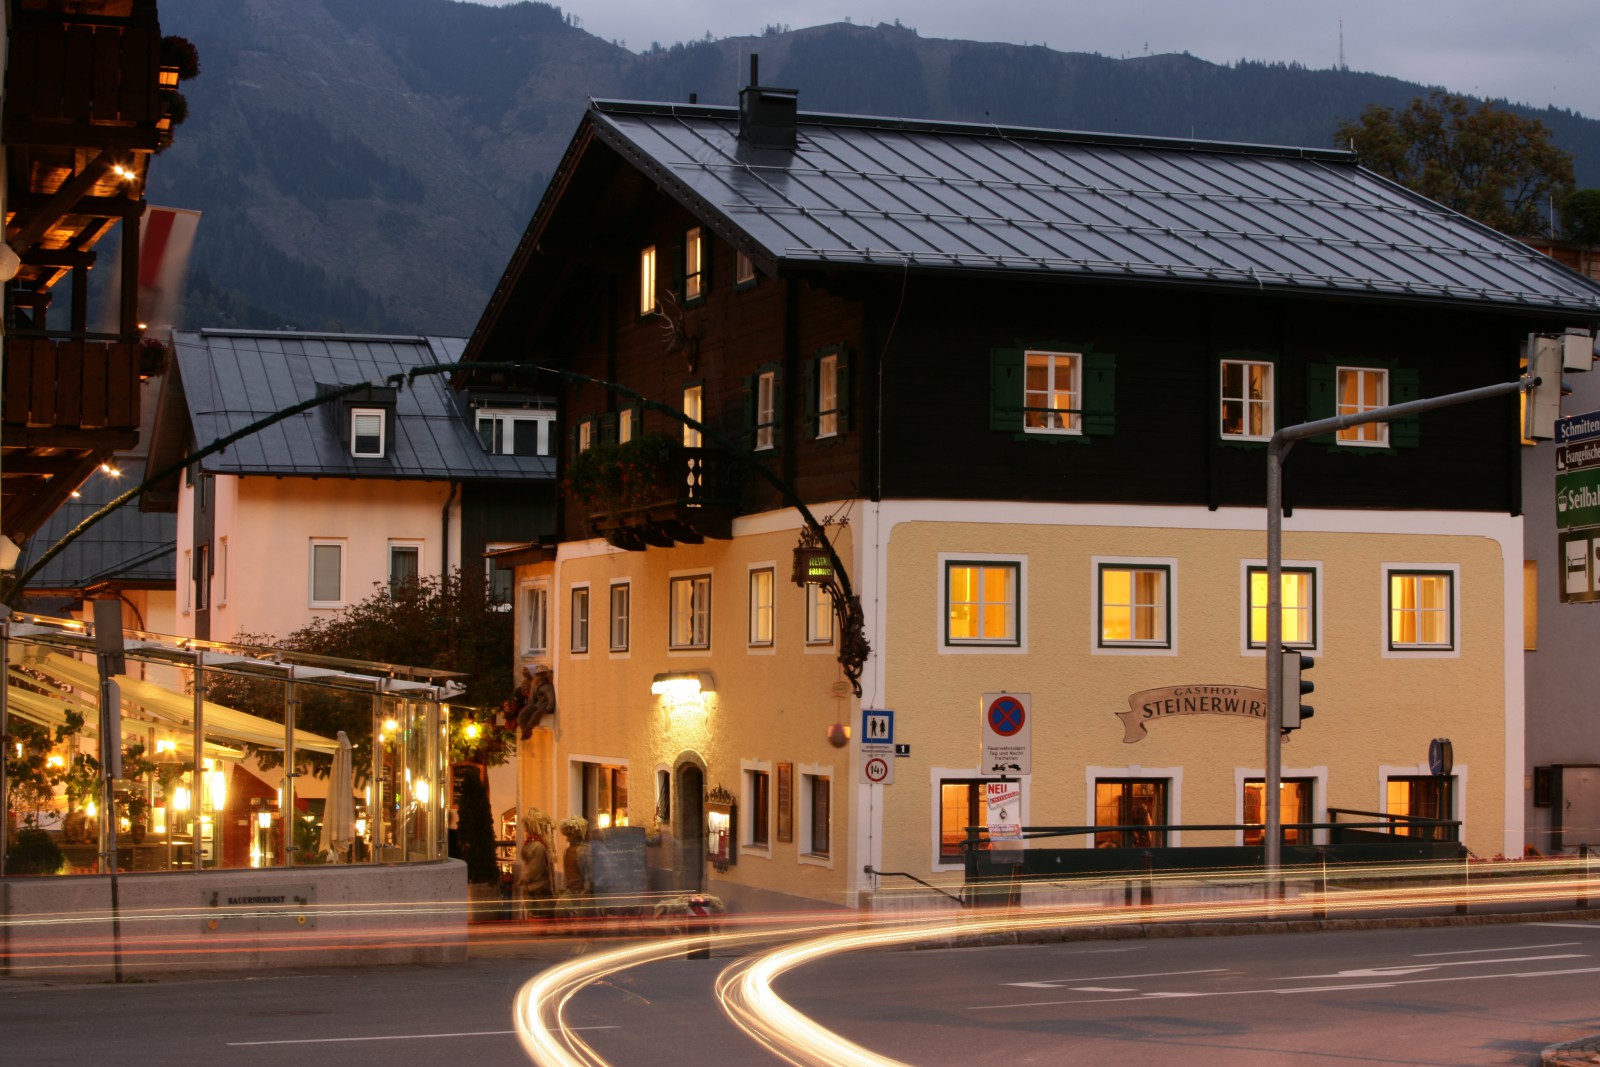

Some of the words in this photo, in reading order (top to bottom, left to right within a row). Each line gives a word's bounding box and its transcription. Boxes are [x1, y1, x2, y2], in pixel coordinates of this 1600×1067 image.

[1174, 686, 1239, 696] GASTHOF
[1142, 696, 1267, 718] STEINERWIRT
[988, 784, 1007, 794] NEU
[228, 896, 285, 904] BAUERNHERBST
